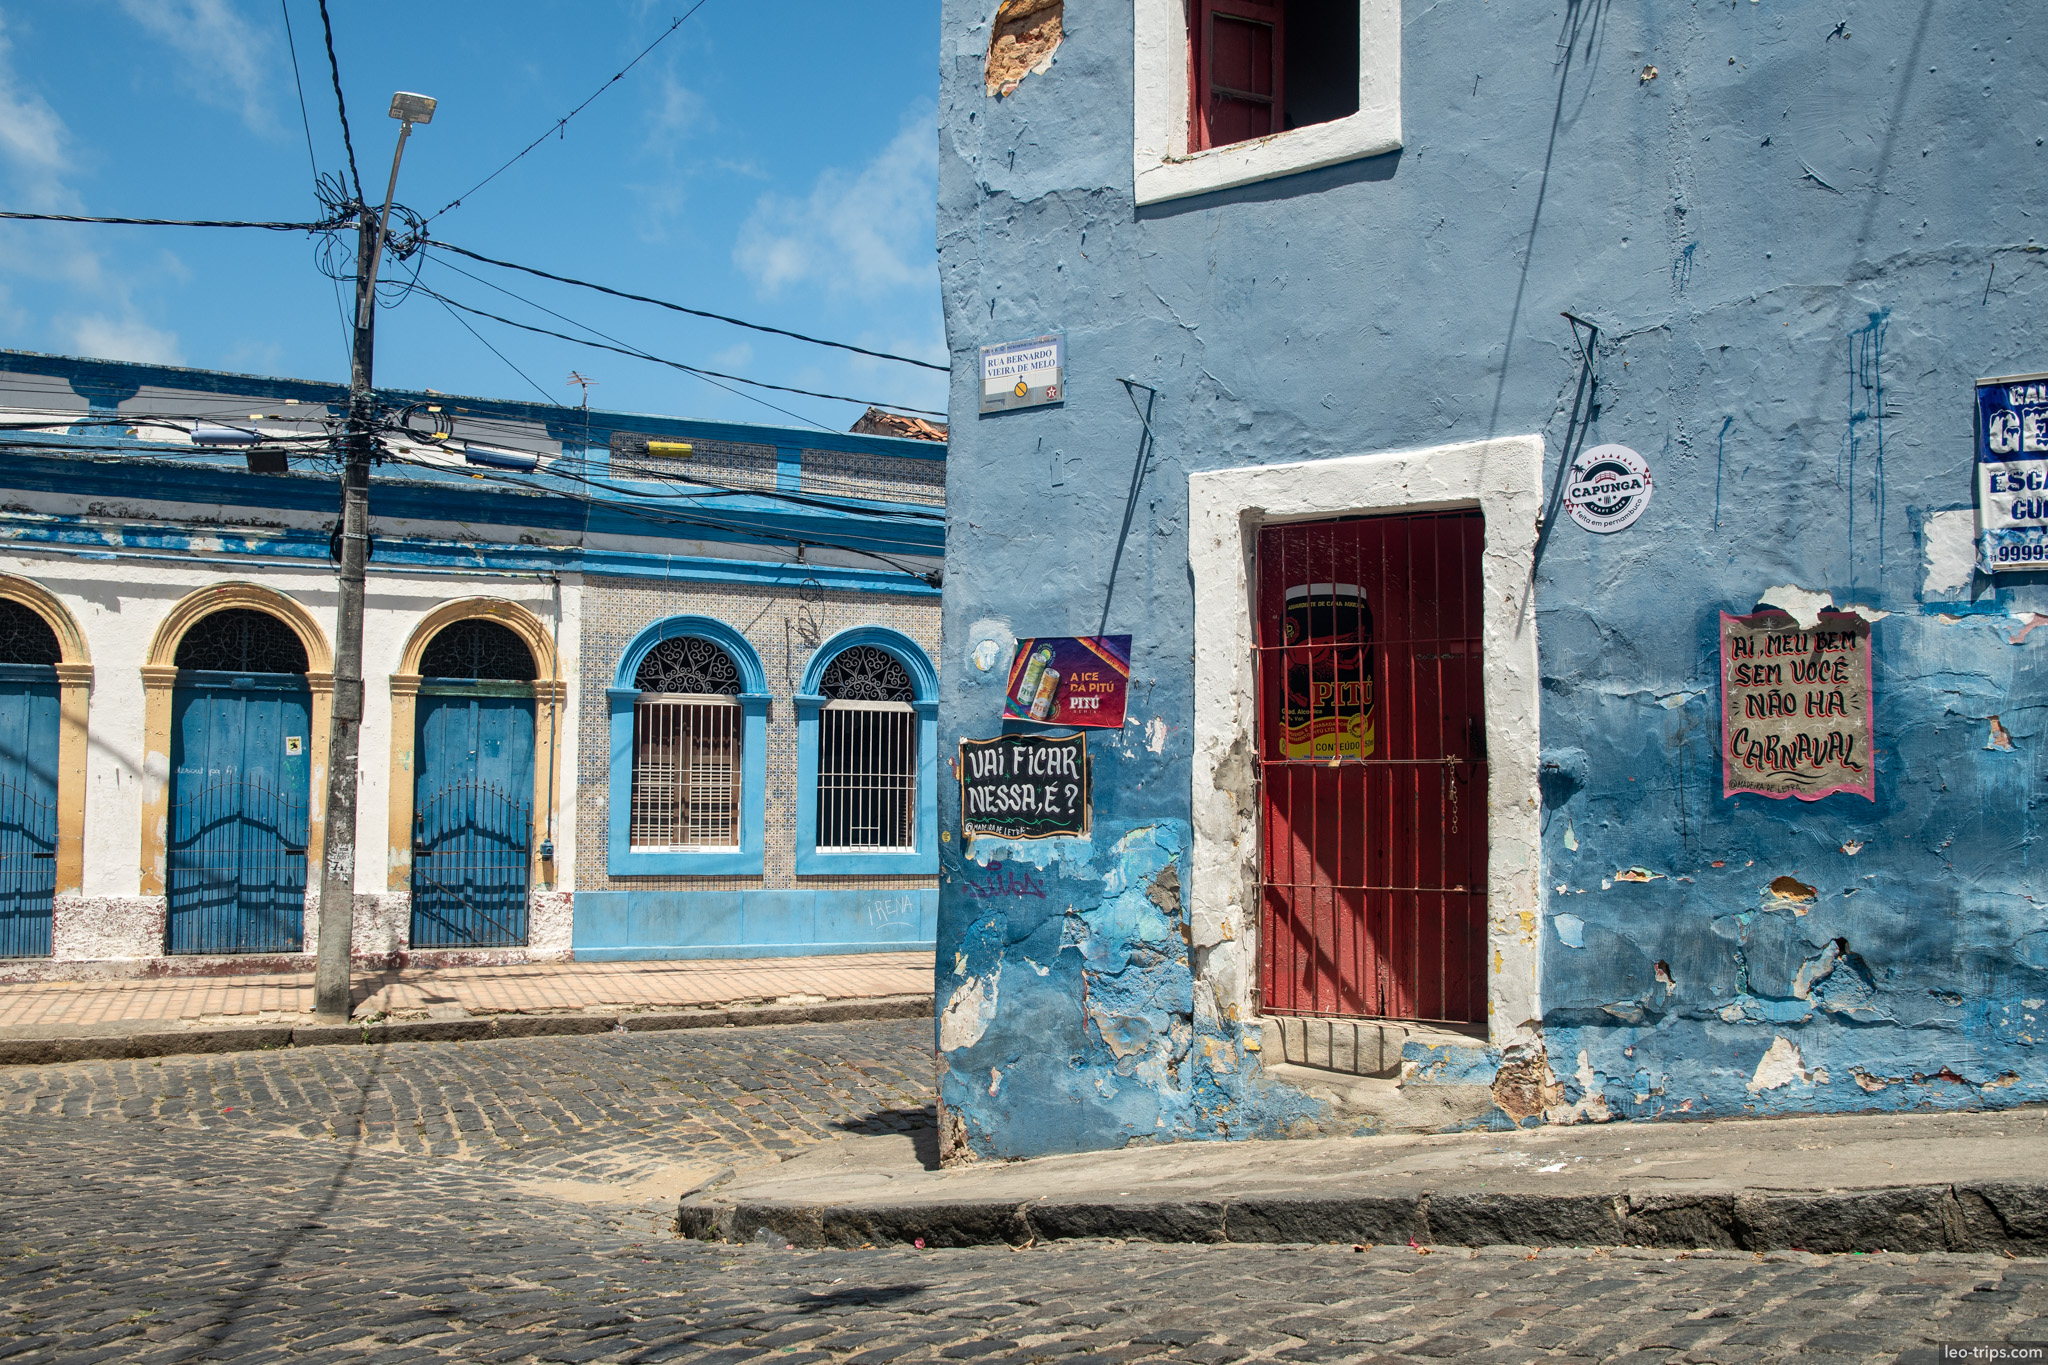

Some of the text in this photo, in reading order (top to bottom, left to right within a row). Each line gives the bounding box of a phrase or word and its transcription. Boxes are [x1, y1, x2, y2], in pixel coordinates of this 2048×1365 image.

[988, 358, 1004, 367] RUA
[1007, 349, 1052, 364] BERNARDO
[988, 359, 1055, 377] VIEIRA DE MELO
[1572, 479, 1642, 498] CAPUNGA
[1576, 511, 1591, 523] feita
[1604, 498, 1642, 528] pernambuco
[1590, 504, 1610, 513] CRAFT
[2011, 495, 2048, 520] CU
[1814, 630, 1856, 653] BEM
[1070, 672, 1099, 681] A ICE
[1734, 656, 1849, 687] SEM VOCÊ
[1070, 681, 1114, 692] DA PITÚ
[1069, 694, 1099, 710] PITÚ
[1745, 685, 1848, 719] NÃO HÁ
[1315, 741, 1359, 751] CONEÚDO
[1730, 727, 1864, 772] CARNAVAL
